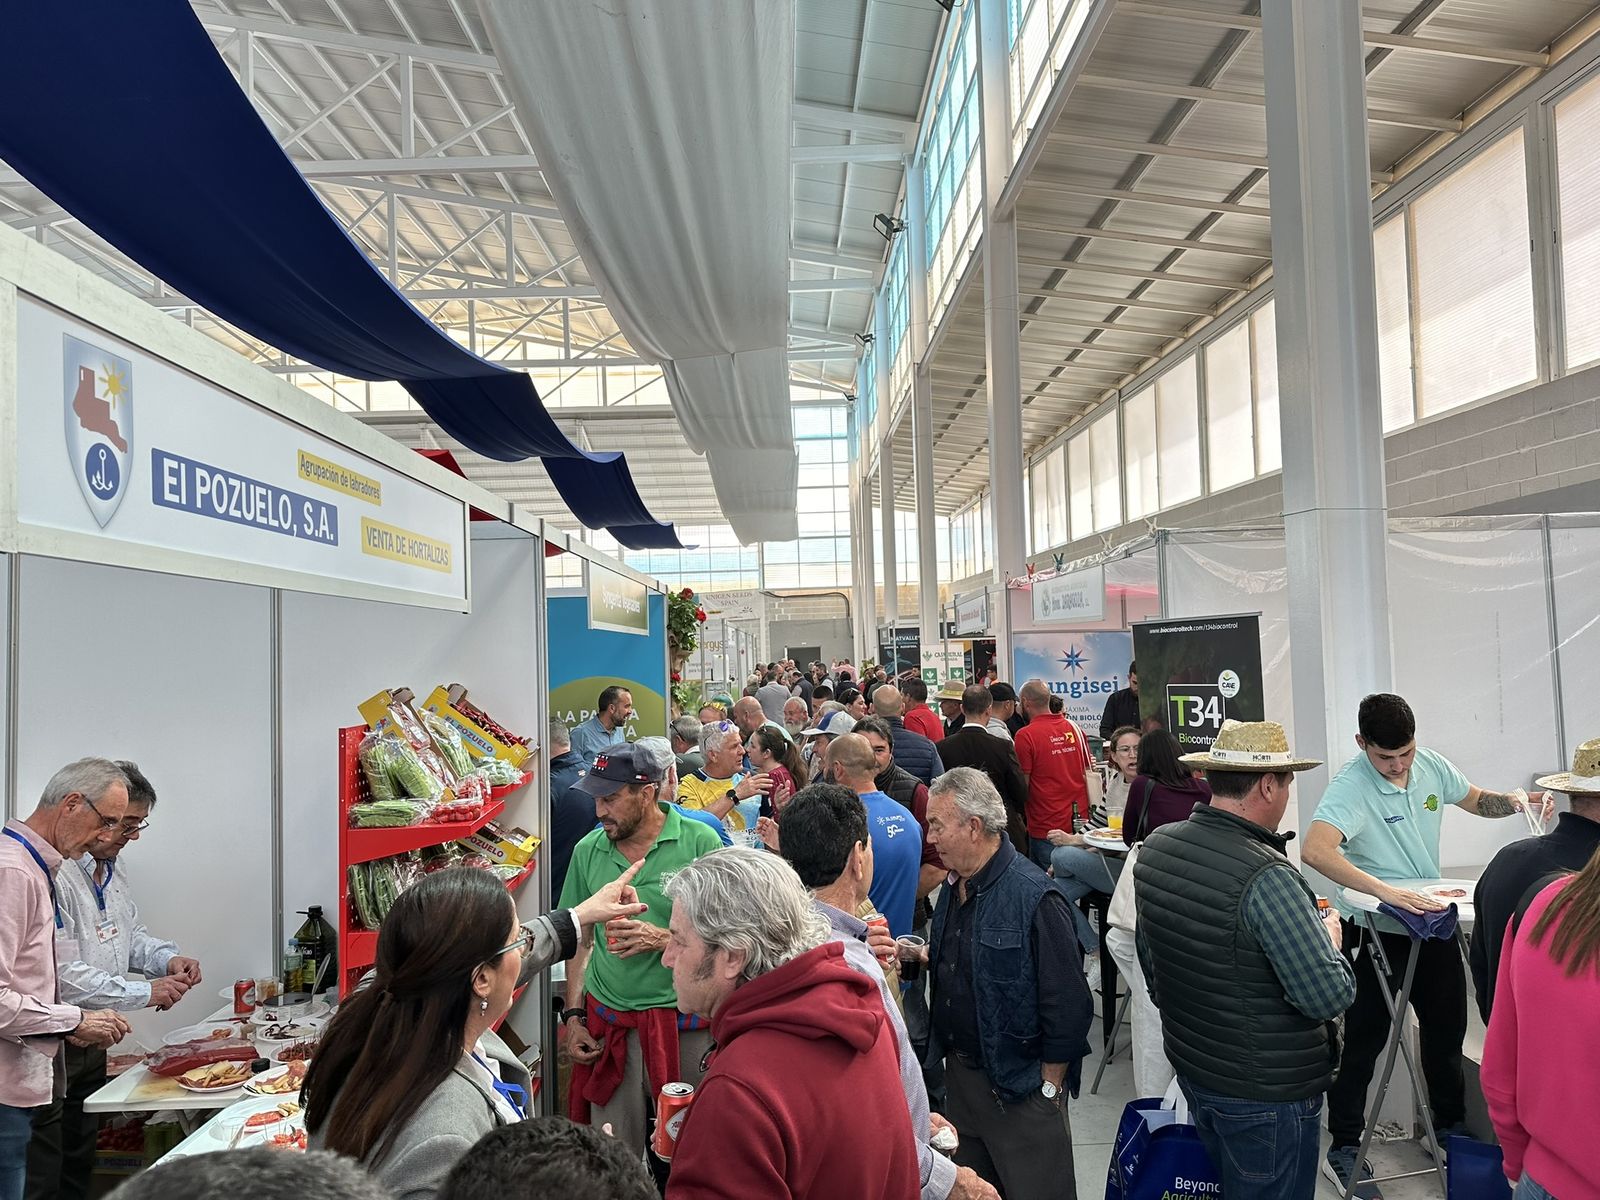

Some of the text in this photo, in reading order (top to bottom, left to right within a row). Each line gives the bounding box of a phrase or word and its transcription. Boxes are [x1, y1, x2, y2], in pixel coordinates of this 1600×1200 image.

[300, 454, 380, 499] Agrupación de labradores
[163, 457, 334, 540] El POZUELO, S.A.
[366, 526, 449, 566] VENTA DE HORTALIZAS
[1048, 676, 1119, 698] ungisei
[557, 710, 576, 723] LA
[1066, 705, 1090, 713] ÁXIMA
[1079, 713, 1102, 721] BIOLÓ
[1170, 695, 1222, 729] T34
[445, 715, 494, 753] EL POZUELO
[1178, 732, 1218, 746] Biocontro
